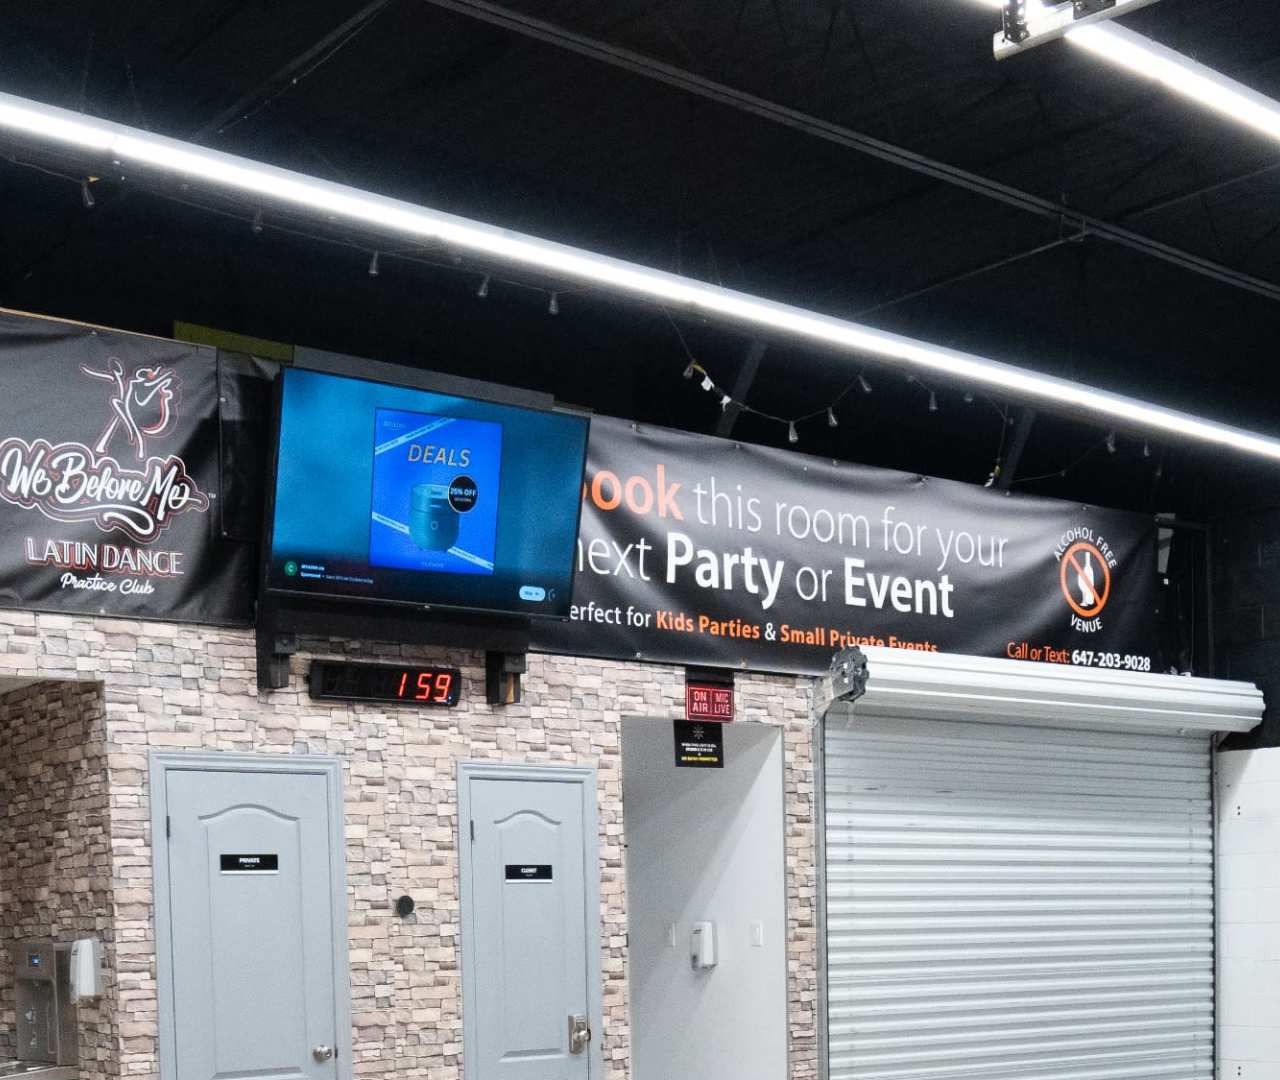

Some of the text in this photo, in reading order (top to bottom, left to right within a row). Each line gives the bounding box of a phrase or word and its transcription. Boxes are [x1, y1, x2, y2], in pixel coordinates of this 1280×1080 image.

[407, 443, 471, 468] DEALS
[1, 447, 52, 499] We
[52, 451, 144, 504] Before
[141, 465, 203, 521] Me
[582, 464, 1009, 572] ook this room for your
[26, 536, 185, 575] LATIN DANCE
[1054, 526, 1117, 569] ALCOHOL FREE
[61, 572, 155, 595] Practice Club
[666, 532, 785, 610] Party
[796, 566, 833, 602] or
[844, 557, 954, 618] Event
[570, 602, 622, 625] erfect
[626, 606, 651, 627] for
[656, 610, 694, 633] Kids
[698, 615, 760, 639] Parties
[764, 623, 777, 641] &
[780, 624, 825, 647] Small
[1071, 613, 1103, 633] VENUE
[1007, 641, 1151, 671] Call or Text: 647-203-9028
[692, 702, 708, 713] AIR
[694, 690, 707, 702] ON
[714, 703, 730, 714] LIVE
[715, 692, 729, 704] MIC
